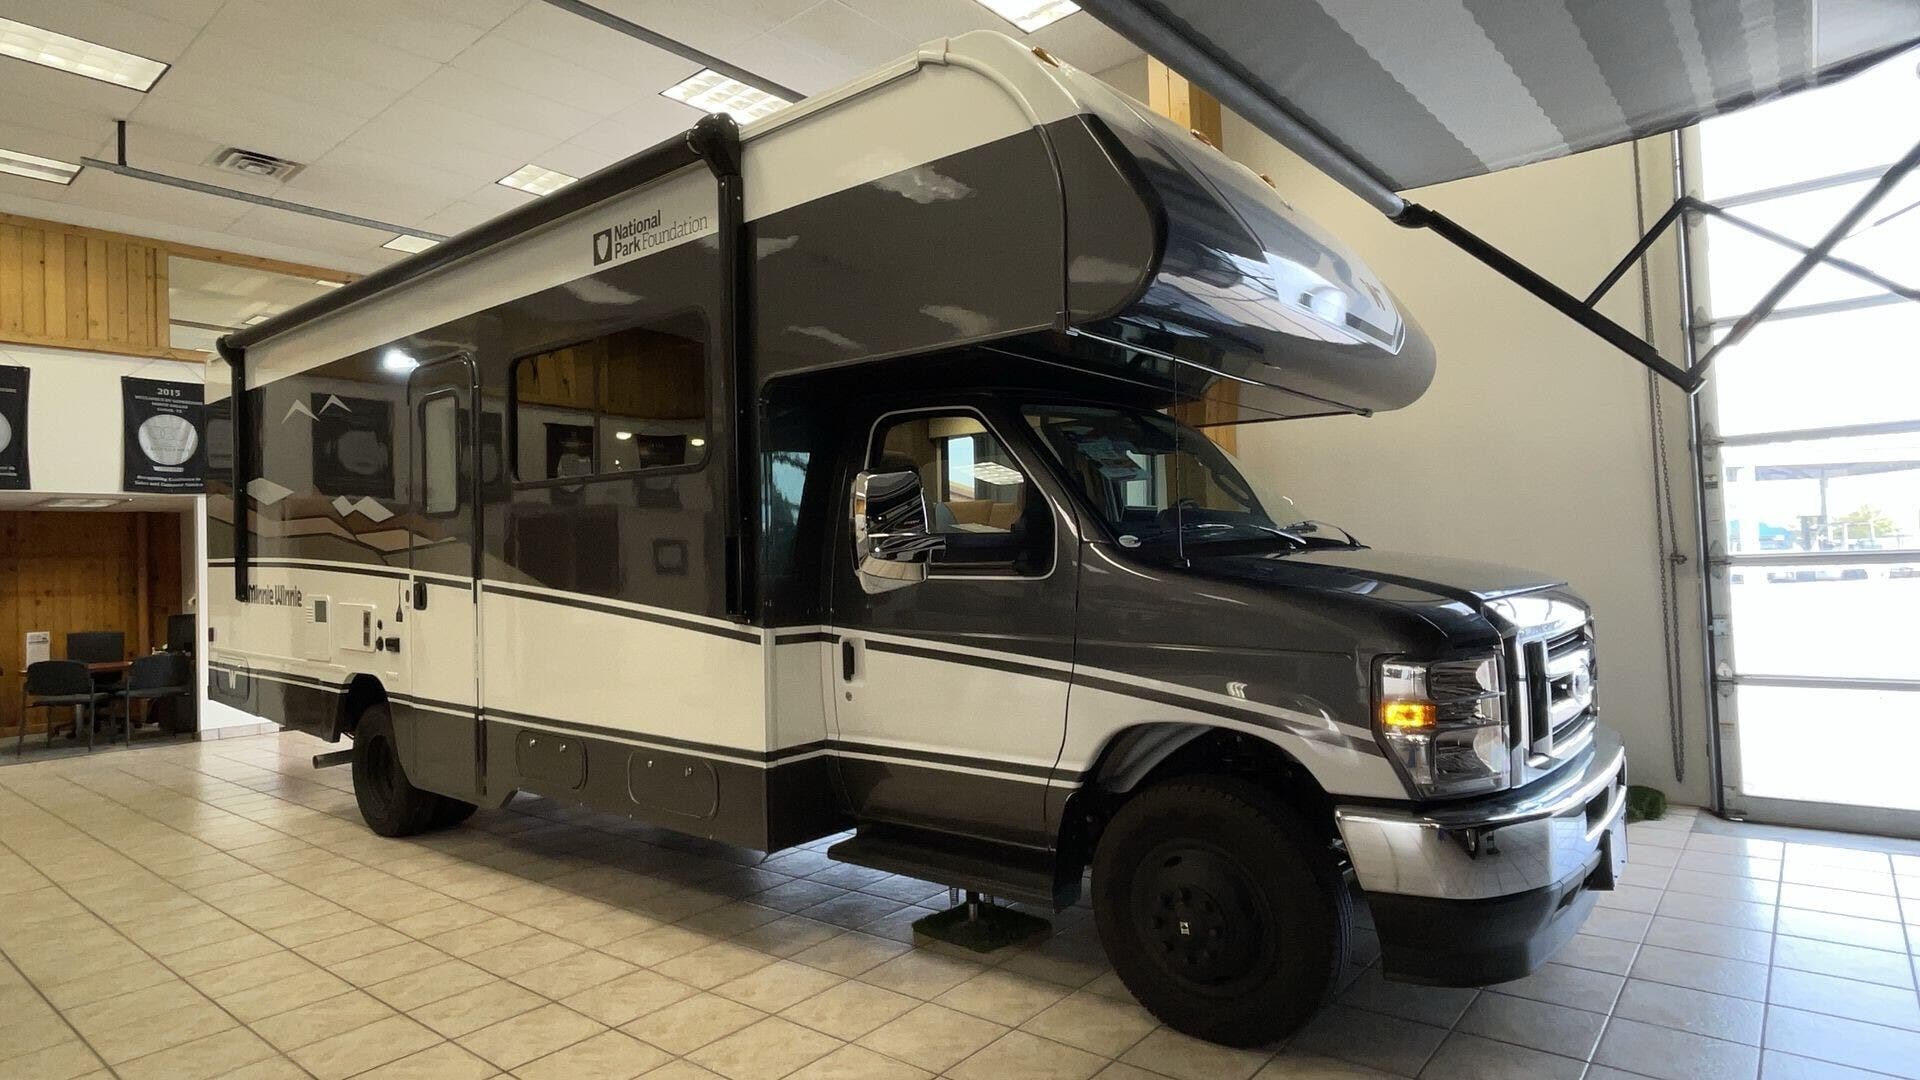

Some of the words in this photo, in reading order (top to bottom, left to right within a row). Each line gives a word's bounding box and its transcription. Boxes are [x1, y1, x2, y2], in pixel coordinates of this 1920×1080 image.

[614, 209, 661, 241] National
[614, 236, 640, 259] Park
[642, 216, 708, 250] Foundation
[156, 387, 181, 397] 2015
[248, 584, 274, 605] Minnie
[275, 584, 303, 607] Winnie
